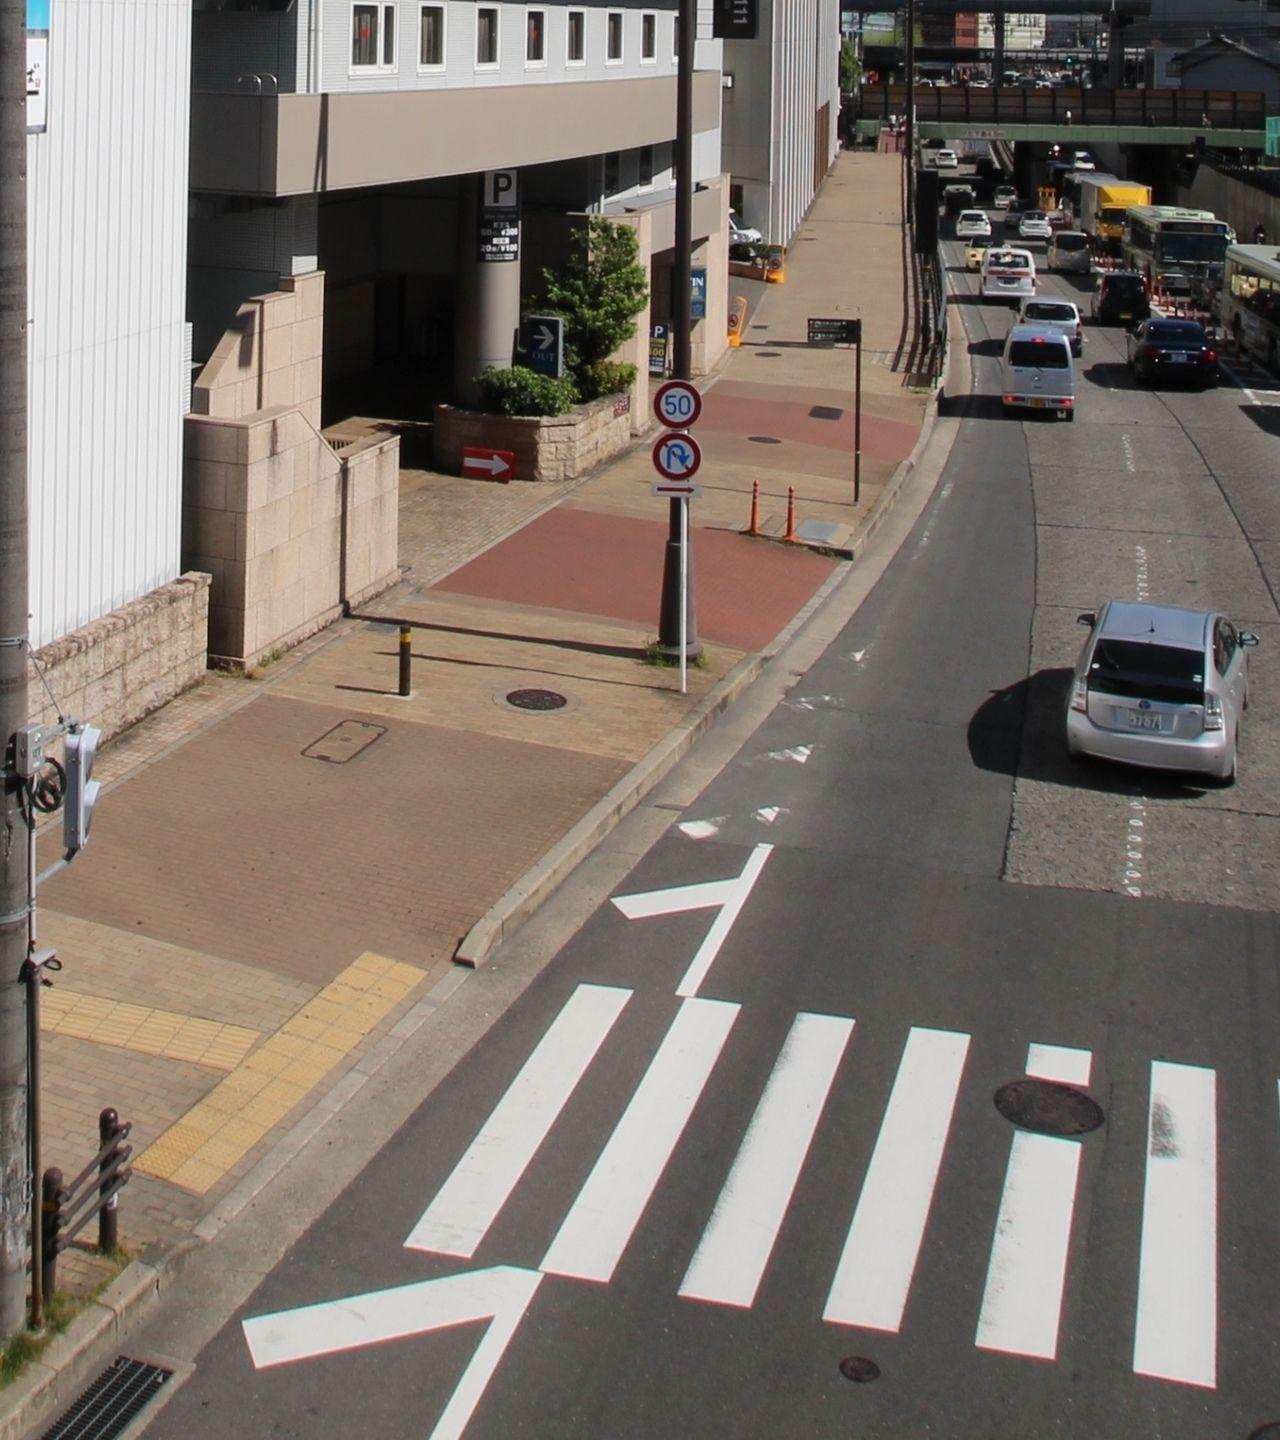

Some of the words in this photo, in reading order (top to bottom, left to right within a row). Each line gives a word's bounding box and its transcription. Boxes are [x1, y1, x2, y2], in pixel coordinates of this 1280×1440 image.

[493, 173, 513, 204] P
[654, 325, 664, 338] P
[664, 394, 691, 416] 50
